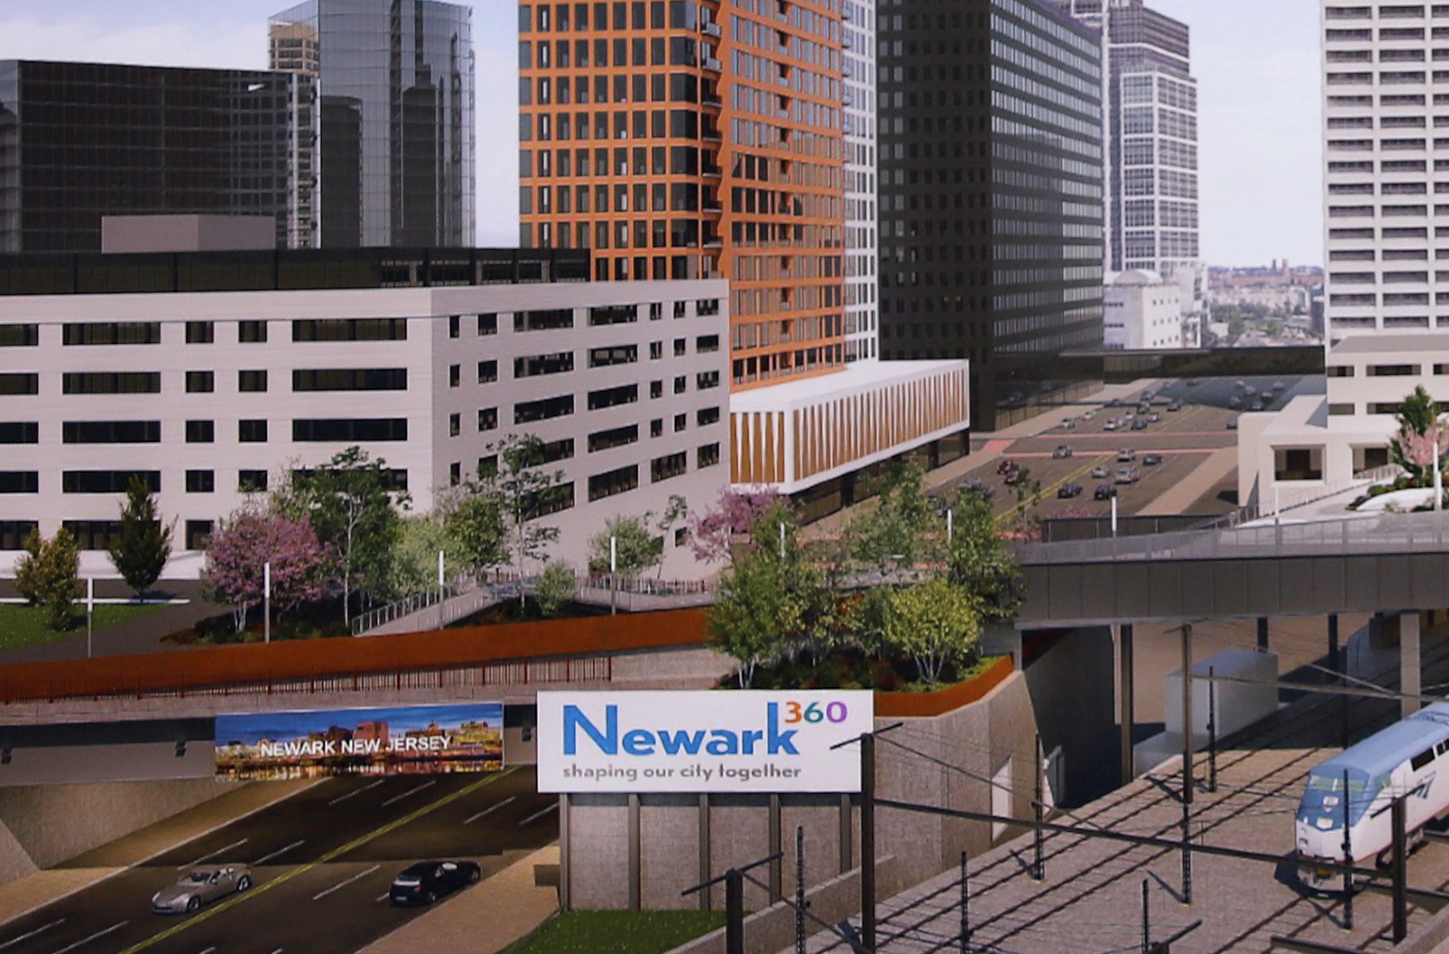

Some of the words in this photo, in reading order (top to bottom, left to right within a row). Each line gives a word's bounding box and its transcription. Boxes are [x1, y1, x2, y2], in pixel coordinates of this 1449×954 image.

[261, 740, 336, 757] NEWARK
[341, 738, 381, 754] NEW
[385, 735, 452, 752] JERSEY
[563, 764, 637, 781] shaping
[643, 768, 674, 778] our
[680, 764, 713, 781] city
[719, 763, 801, 781] together
